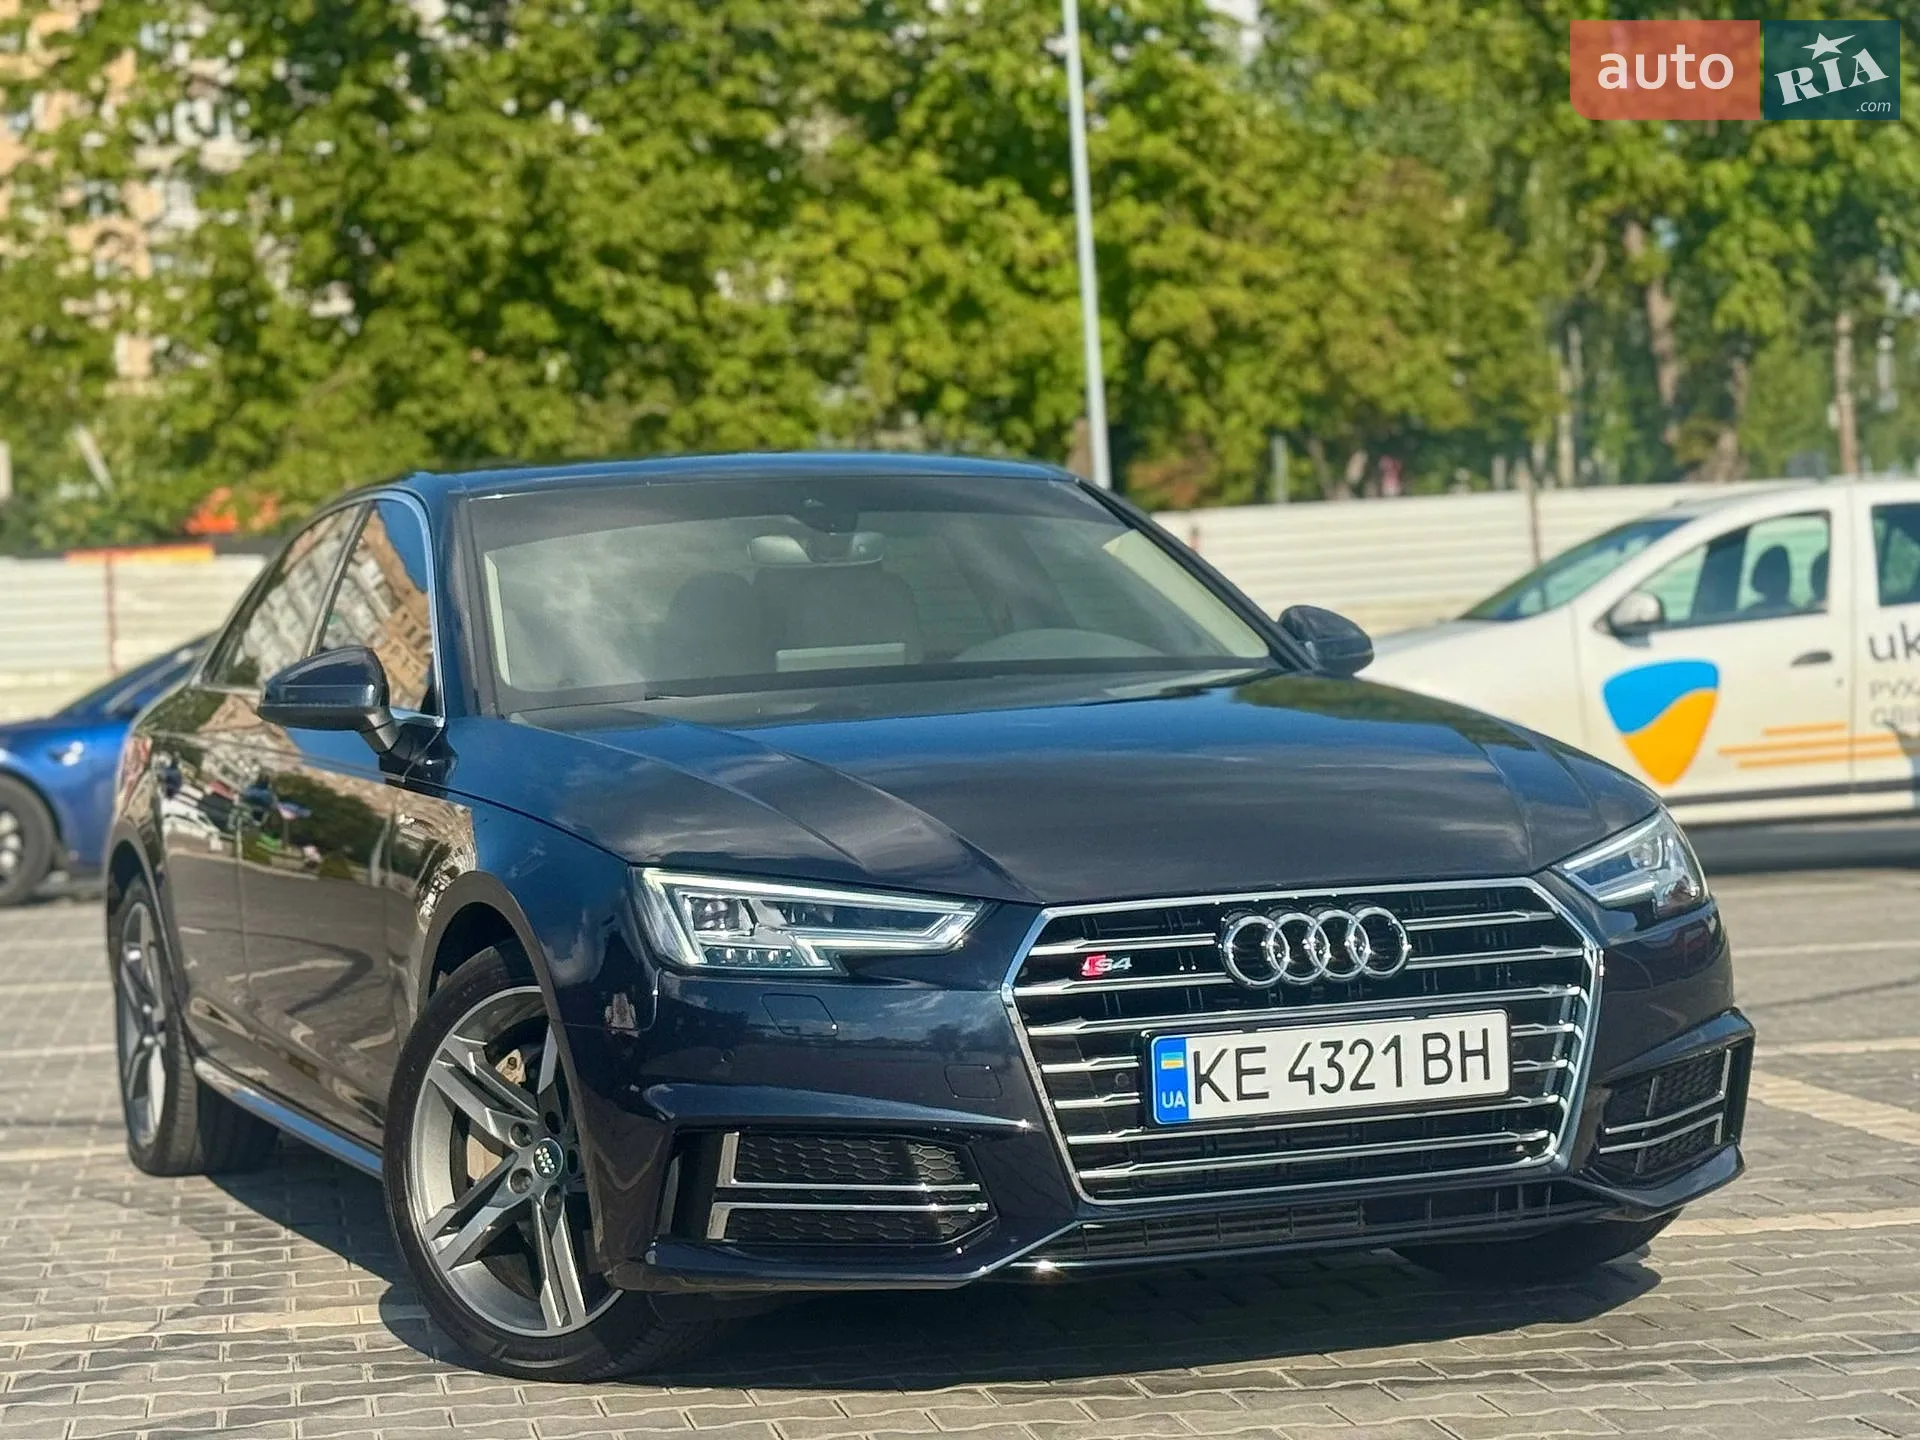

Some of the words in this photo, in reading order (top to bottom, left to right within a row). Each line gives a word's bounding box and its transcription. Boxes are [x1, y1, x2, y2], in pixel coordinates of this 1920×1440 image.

[1088, 955, 1133, 973] S4
[1193, 1046, 1269, 1105] KE
[1288, 1034, 1404, 1096] 4321
[1422, 1027, 1491, 1086] BH
[1162, 1091, 1186, 1109] UA
